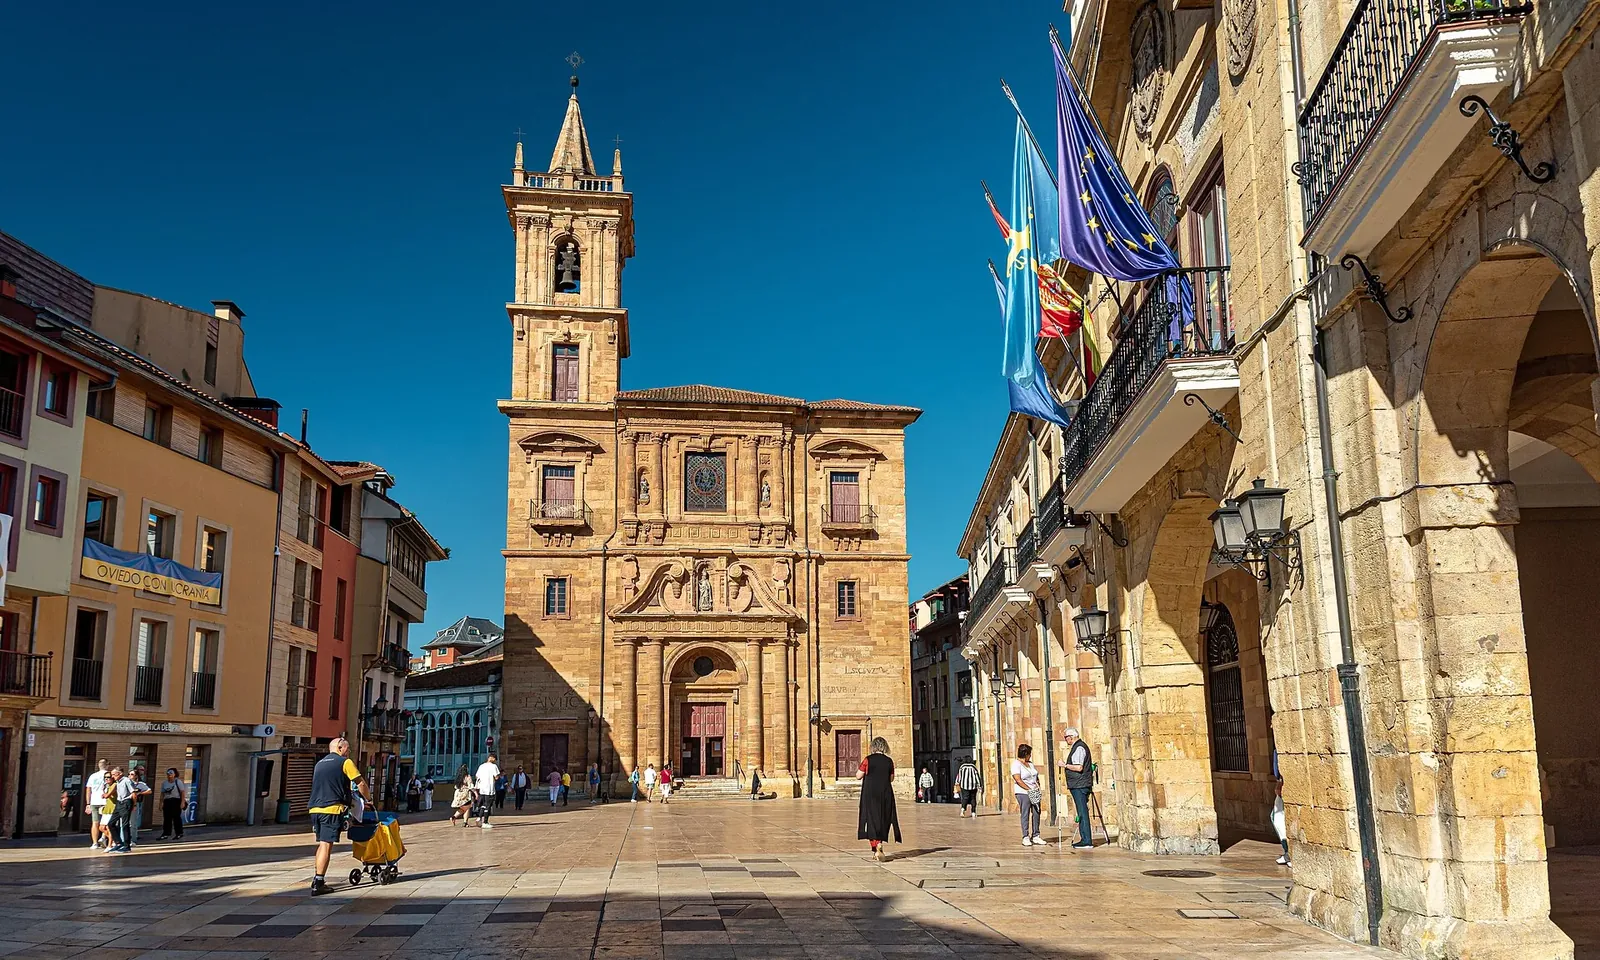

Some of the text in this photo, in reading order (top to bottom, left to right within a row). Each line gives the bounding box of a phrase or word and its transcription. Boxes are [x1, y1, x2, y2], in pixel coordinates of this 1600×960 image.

[97, 564, 210, 601] OVIEDO CON UCRANIA
[58, 718, 83, 728] CENTRO
